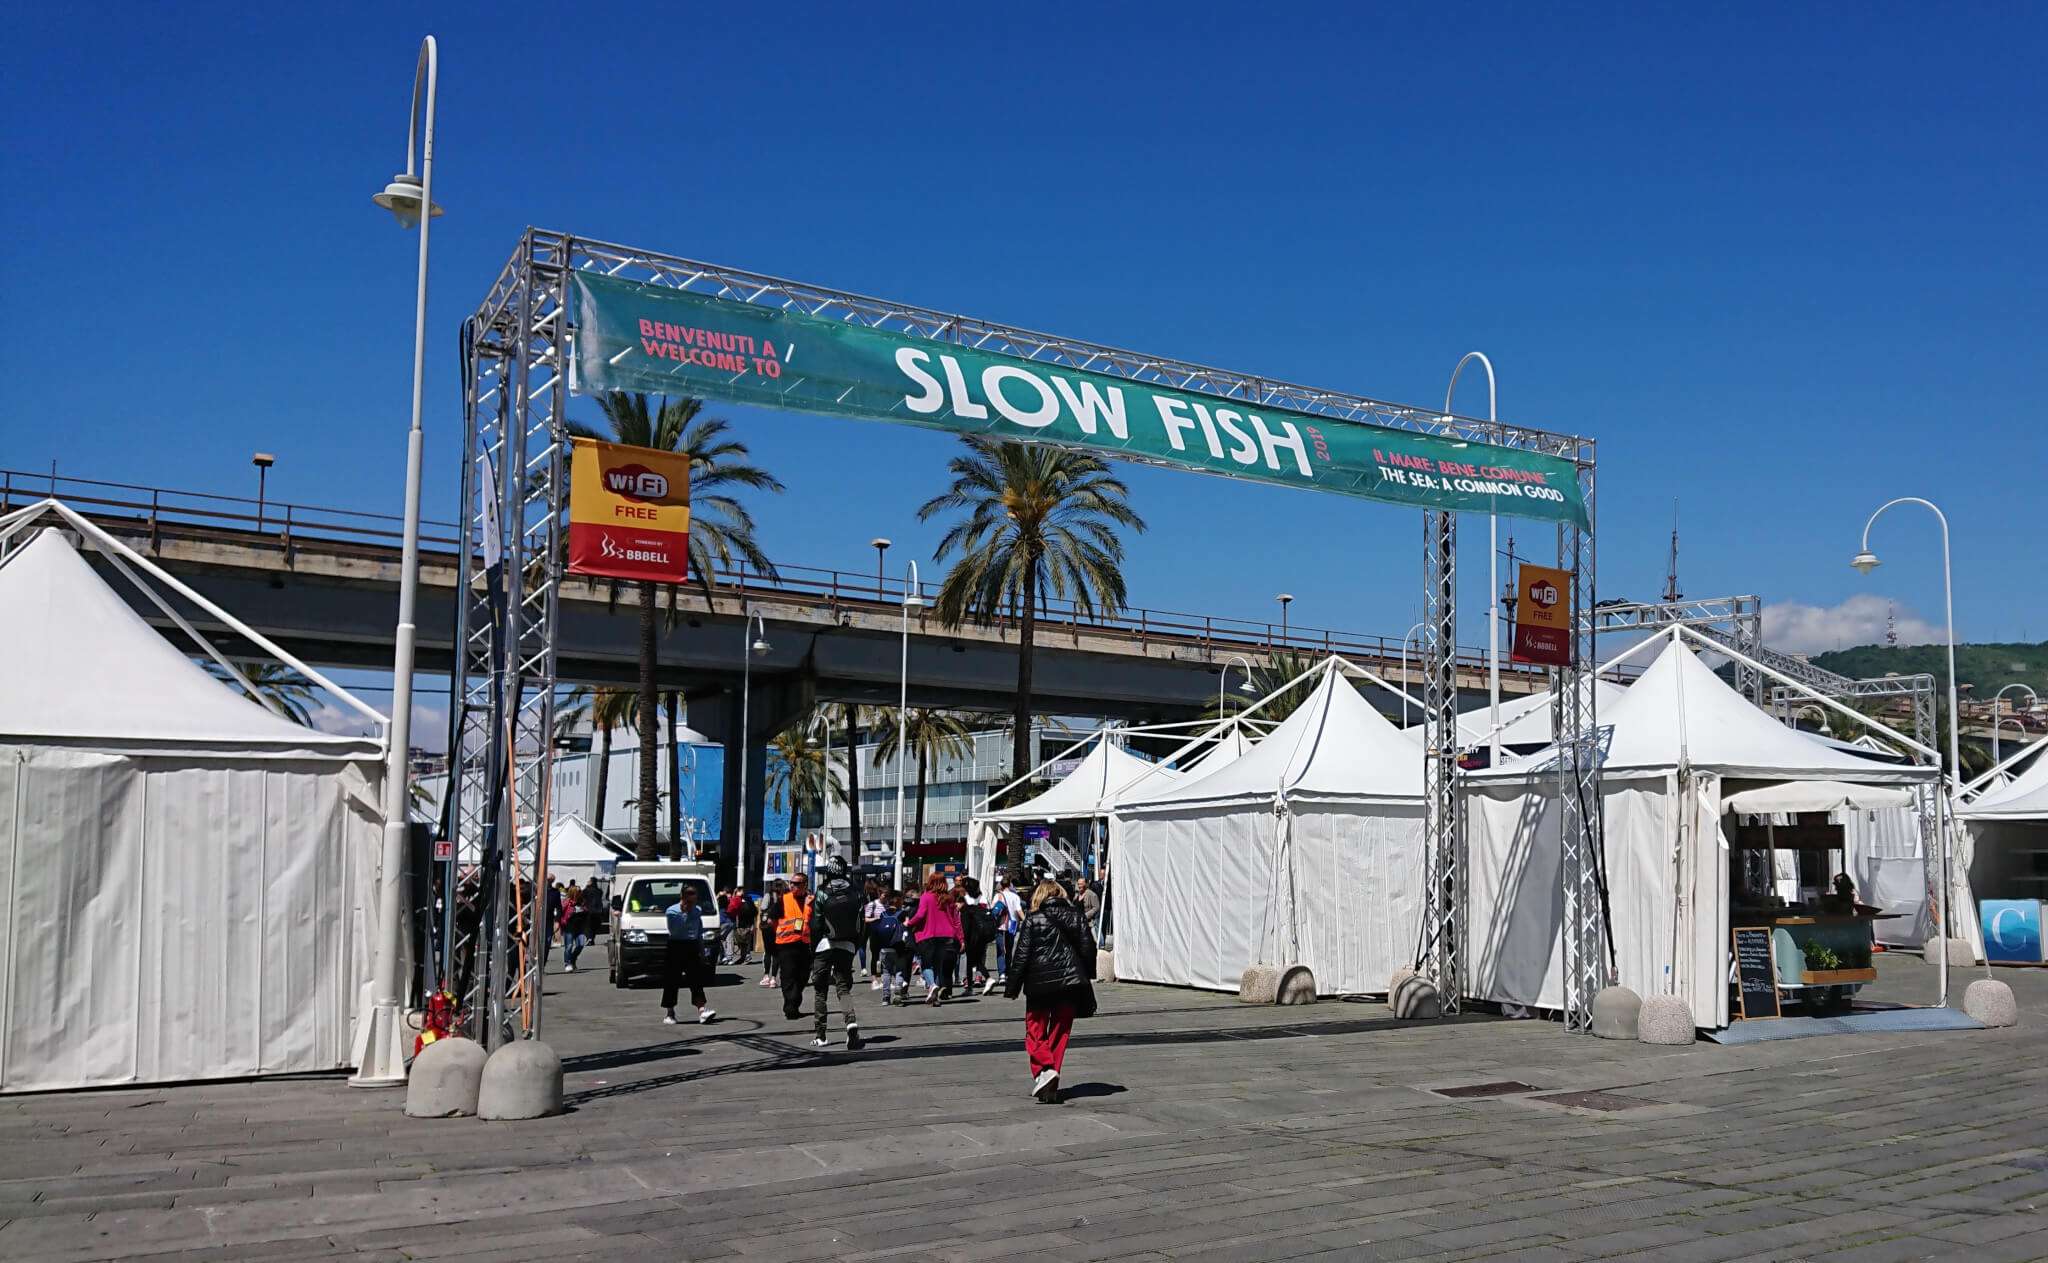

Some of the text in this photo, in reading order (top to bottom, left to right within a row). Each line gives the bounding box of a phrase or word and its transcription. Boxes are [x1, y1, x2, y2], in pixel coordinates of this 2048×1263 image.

[639, 319, 776, 358] BENVENUTI A
[641, 337, 781, 378] WELCOME TO
[895, 347, 1314, 477] SLOW FISH
[1306, 426, 1331, 461] 2019
[1375, 449, 1546, 483] IL MARE: BENE COMUNE
[1378, 466, 1564, 502] THE SEA: A COMMON GOOD
[615, 505, 657, 520] FREE
[626, 550, 670, 564] BBBELL
[1533, 611, 1553, 620] FREE
[1992, 908, 2026, 950] C
